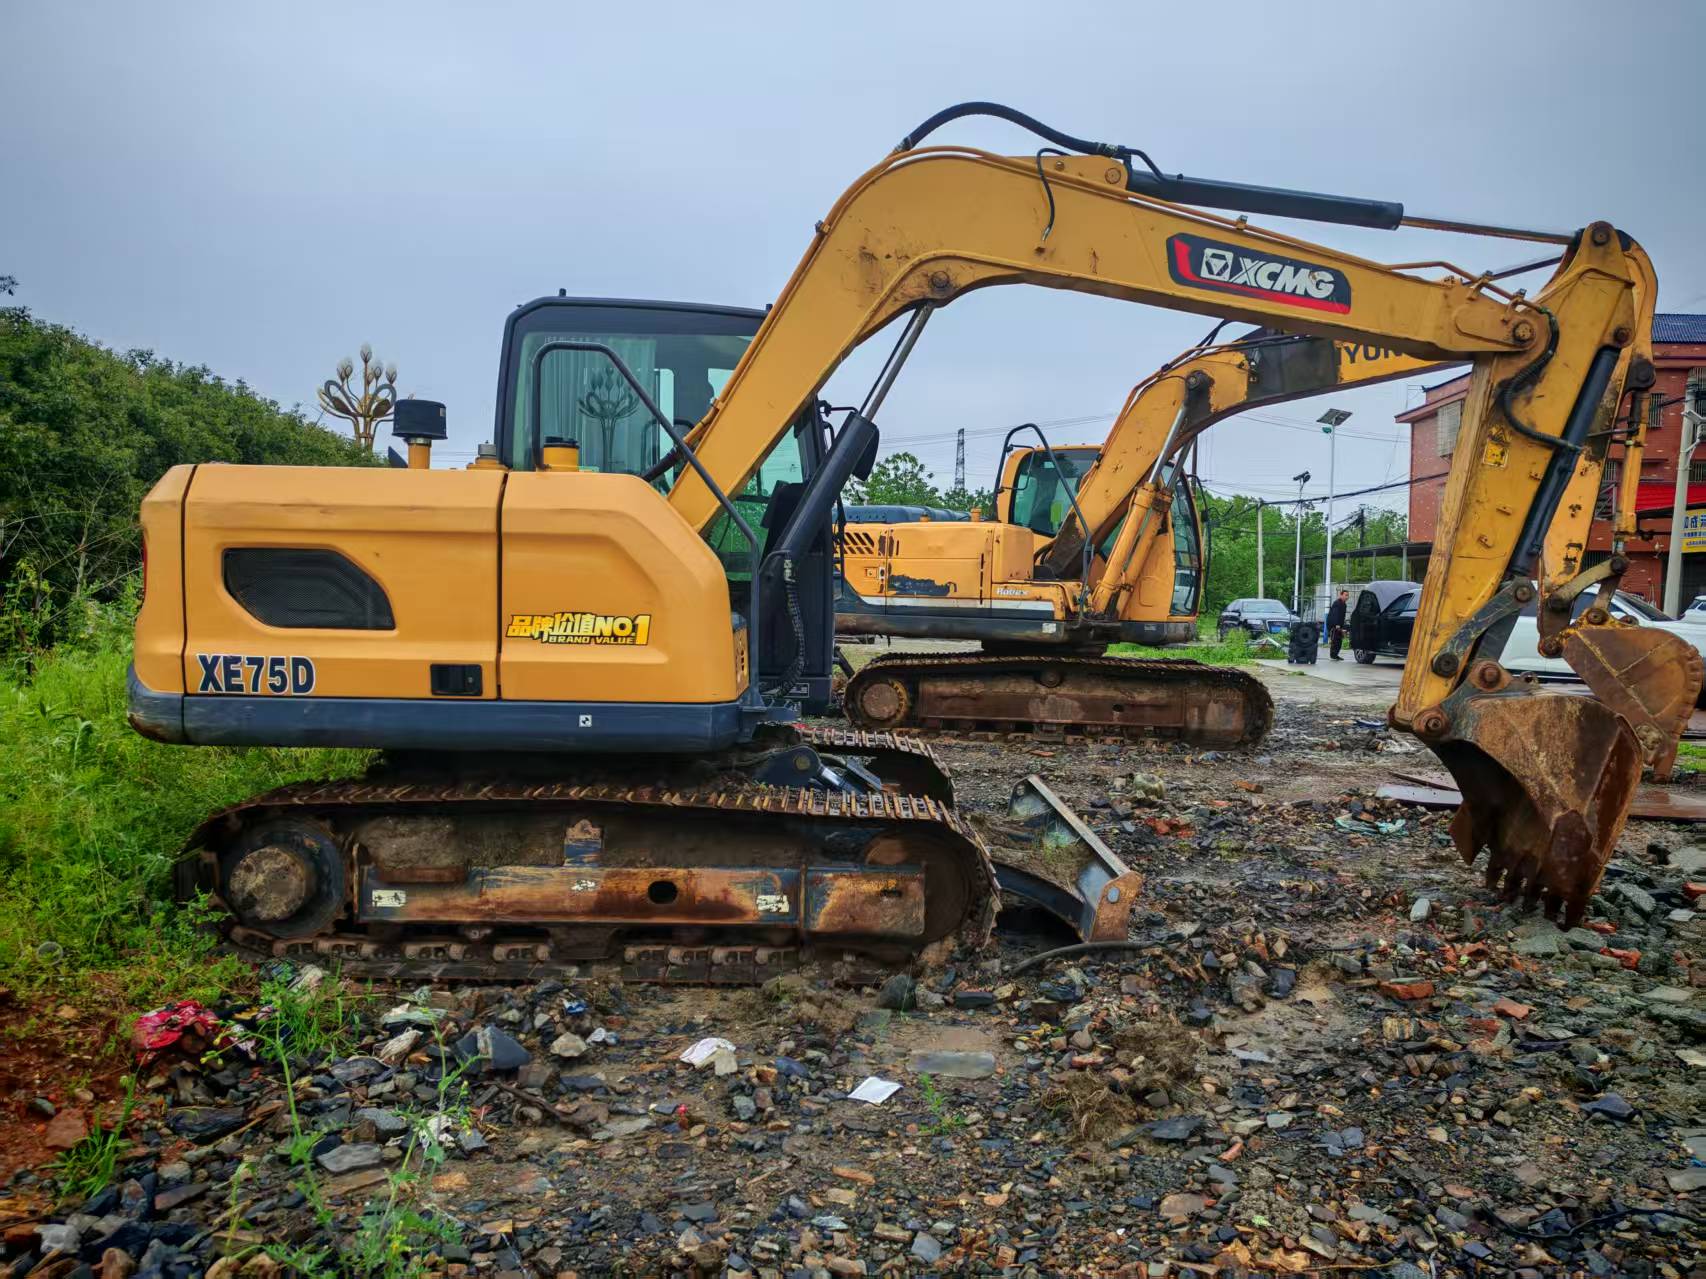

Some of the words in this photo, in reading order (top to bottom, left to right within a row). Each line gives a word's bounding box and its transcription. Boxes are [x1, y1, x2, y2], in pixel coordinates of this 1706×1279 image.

[1229, 256, 1335, 299] XCMG
[548, 635, 590, 643] BRAND
[596, 636, 636, 644] VALUE
[196, 654, 316, 695] XE75D
